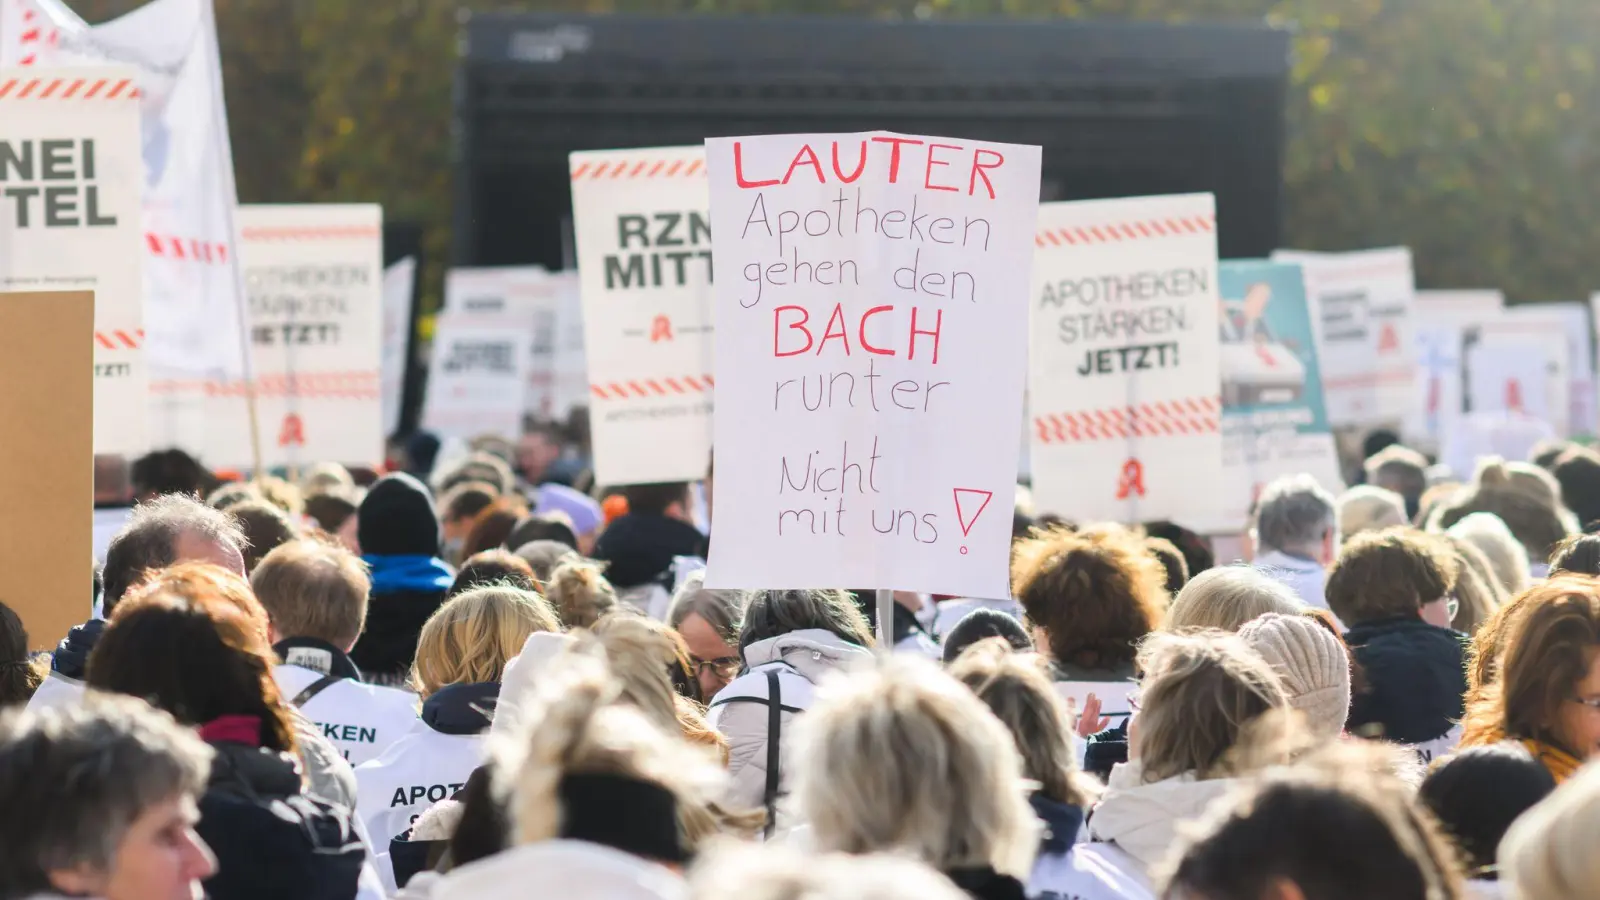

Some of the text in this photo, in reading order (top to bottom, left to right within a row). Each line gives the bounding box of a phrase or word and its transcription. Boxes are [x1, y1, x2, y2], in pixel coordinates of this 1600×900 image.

[0, 139, 95, 181] NEI
[734, 137, 1004, 200] LAUTER
[0, 185, 117, 228] TEL
[742, 187, 990, 257] Apotheken
[740, 247, 975, 308] gehen den
[1040, 268, 1208, 310] APOTHEKEN
[773, 302, 942, 365] BACH
[1077, 342, 1180, 377] JETZT!
[775, 358, 950, 412] runter
[780, 436, 881, 494] Nicht
[779, 497, 846, 537] mit
[872, 510, 938, 543] uns
